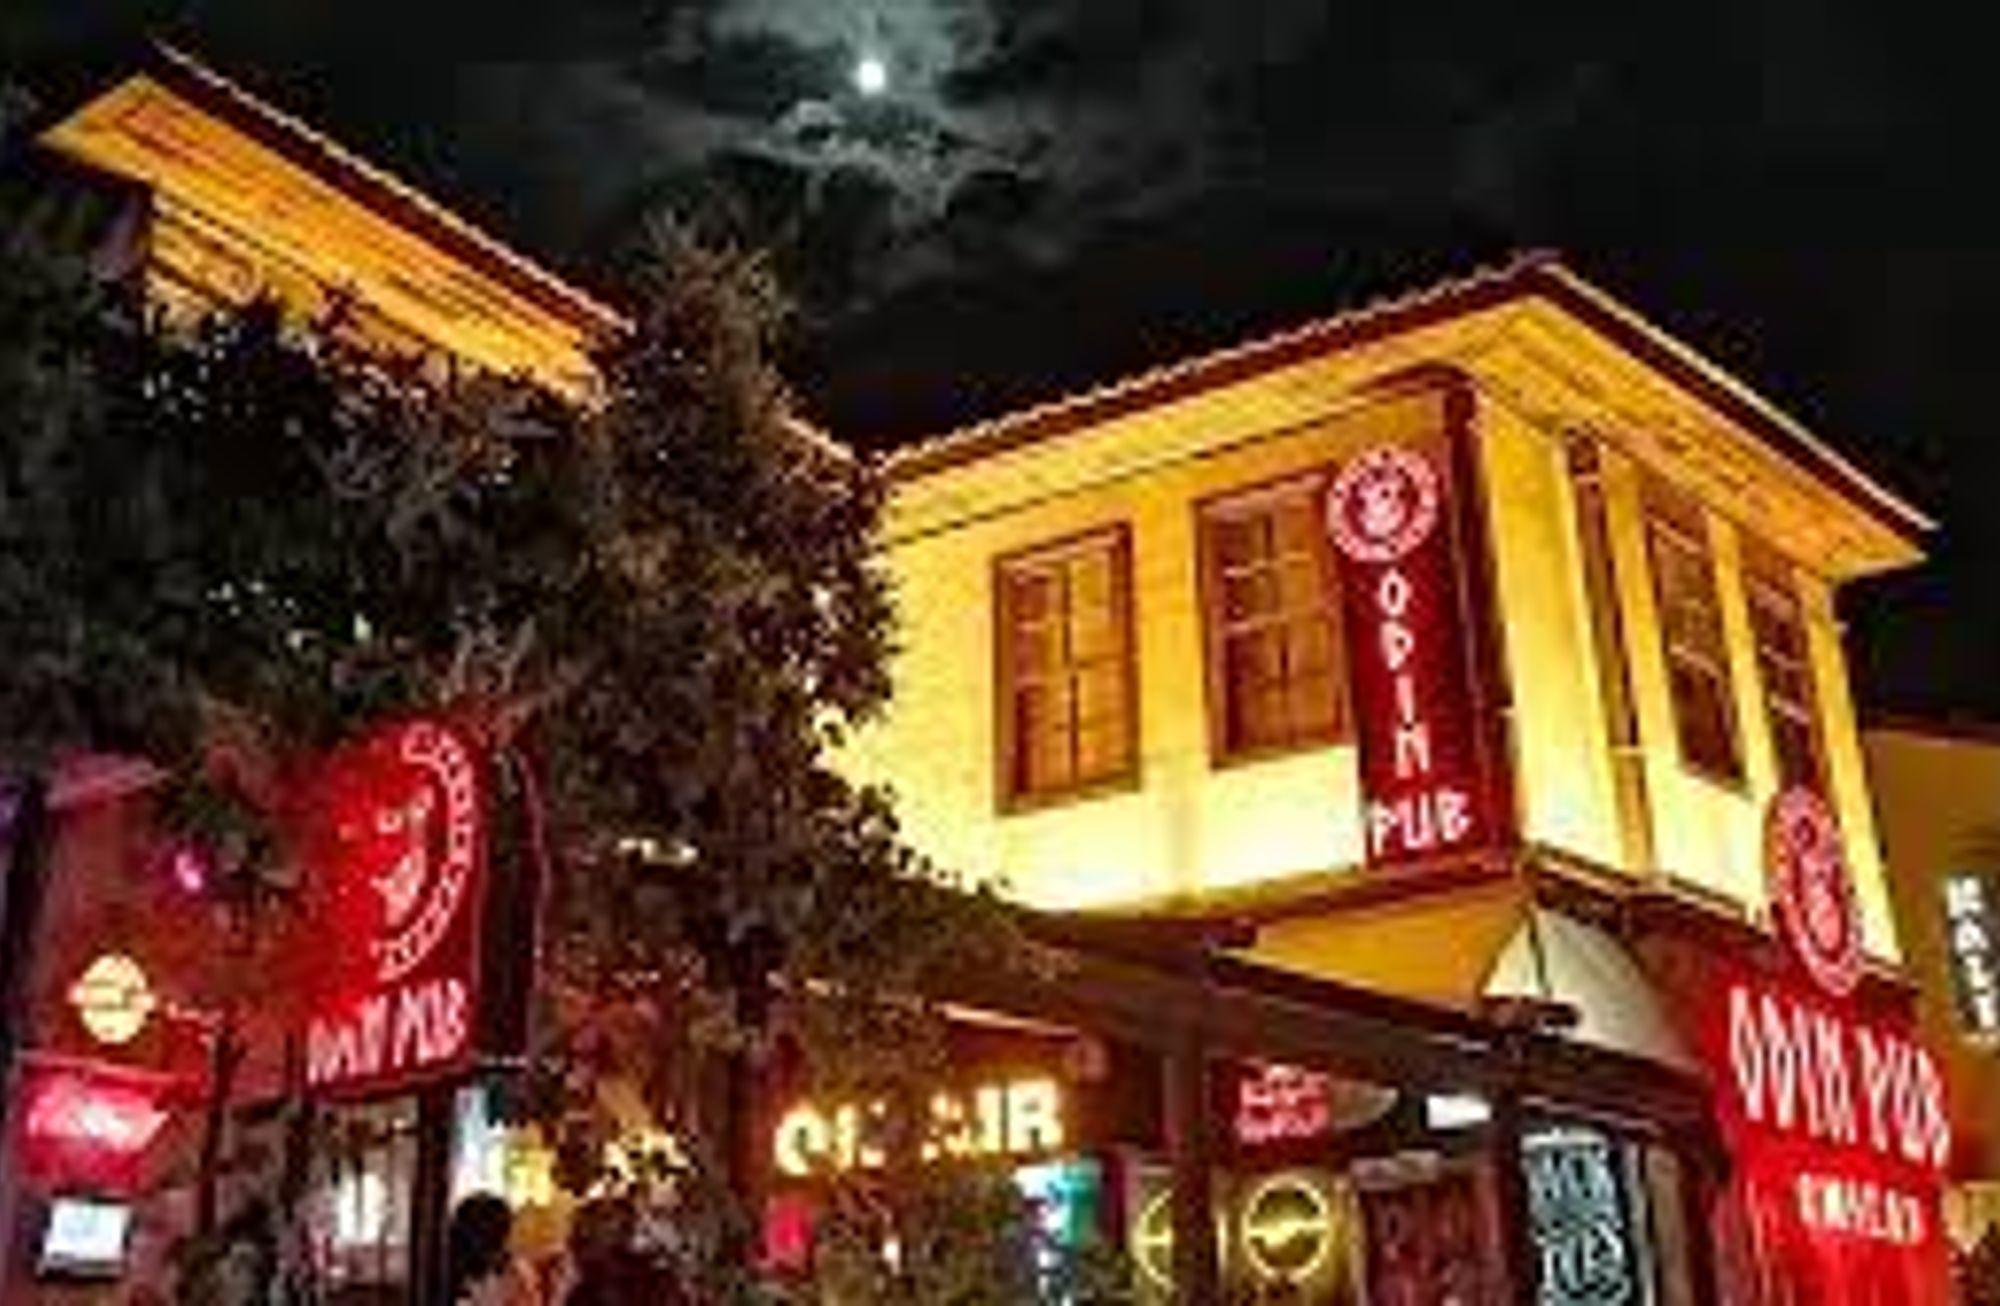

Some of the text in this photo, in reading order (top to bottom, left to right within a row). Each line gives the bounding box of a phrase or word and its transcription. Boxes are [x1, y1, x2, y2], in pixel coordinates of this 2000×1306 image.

[1378, 568, 1430, 779] ODIN
[1367, 788, 1472, 857] PUB
[1728, 984, 1950, 1168] ODIN PUB
